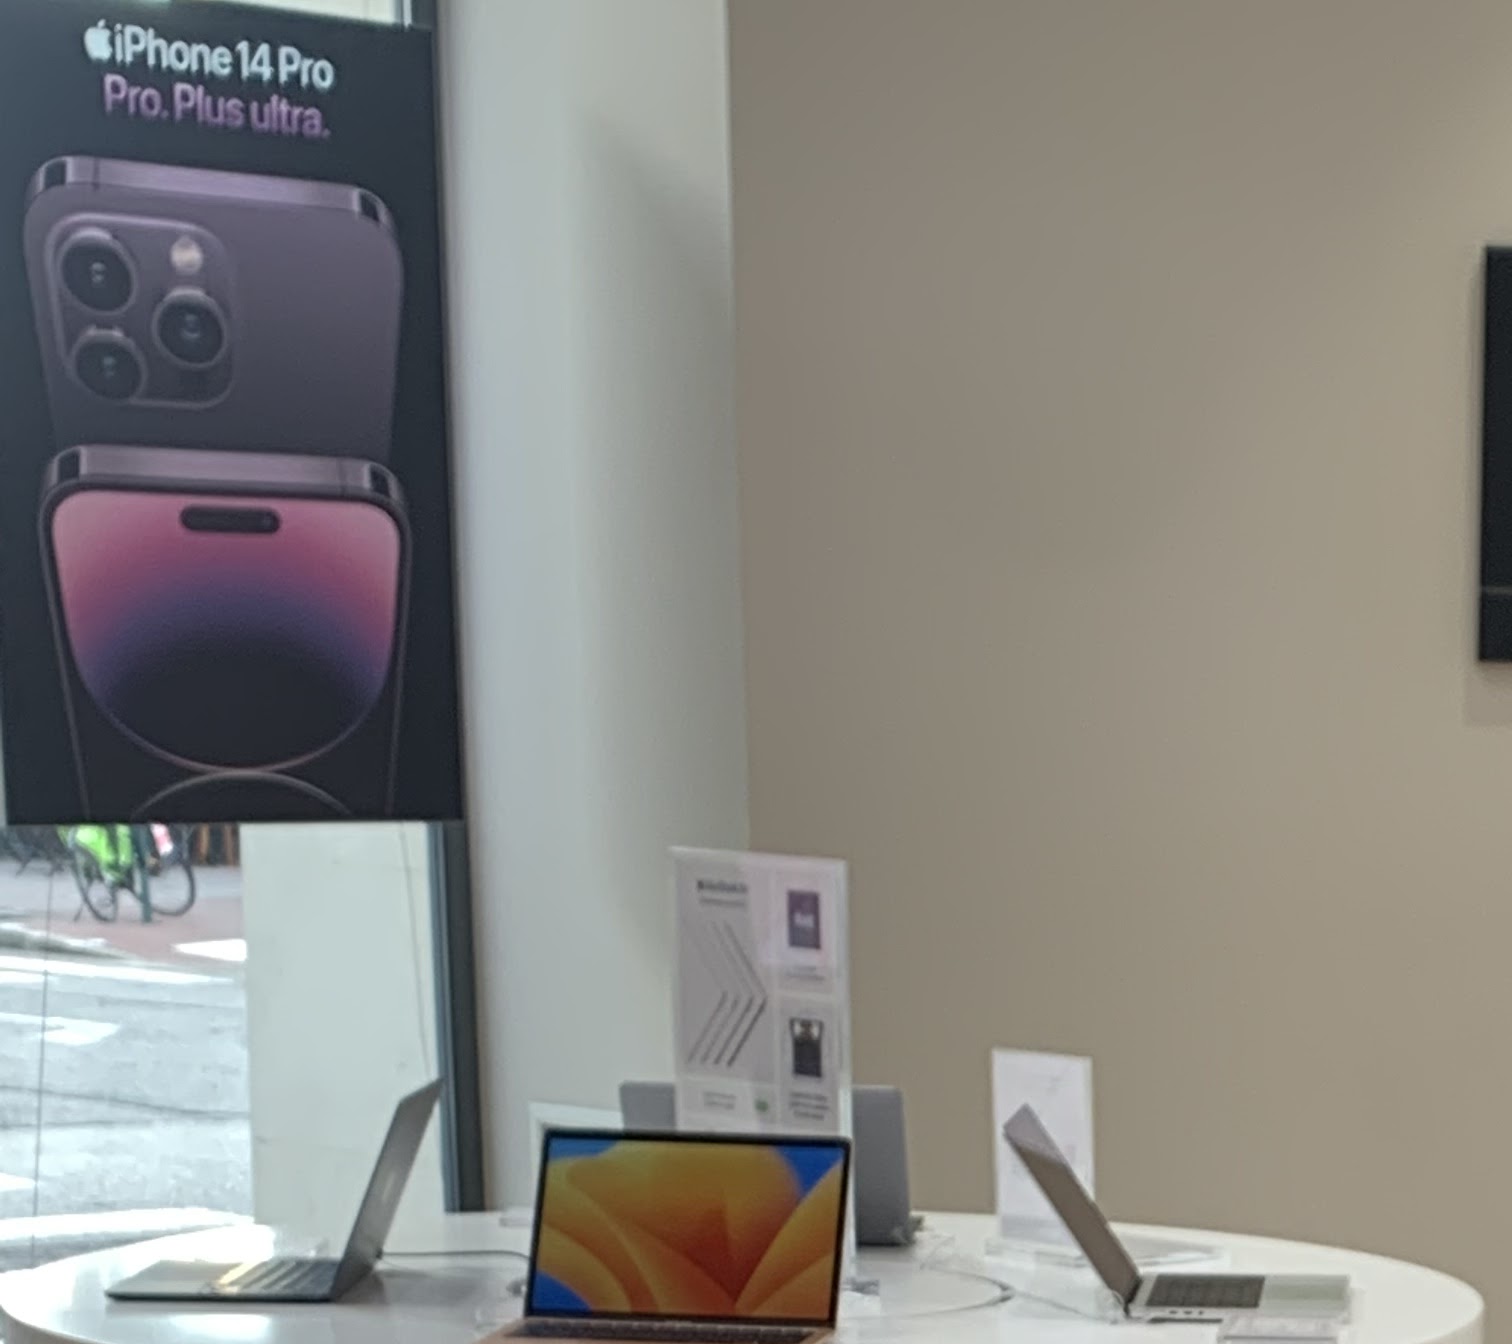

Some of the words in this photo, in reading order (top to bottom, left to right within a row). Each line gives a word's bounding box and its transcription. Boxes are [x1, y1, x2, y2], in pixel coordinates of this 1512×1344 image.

[114, 22, 232, 77] iPhone
[235, 40, 273, 82] 14
[277, 45, 334, 91] Pro
[104, 73, 168, 119] Pro.
[173, 81, 244, 129] Plus
[250, 93, 331, 139] ultra.
